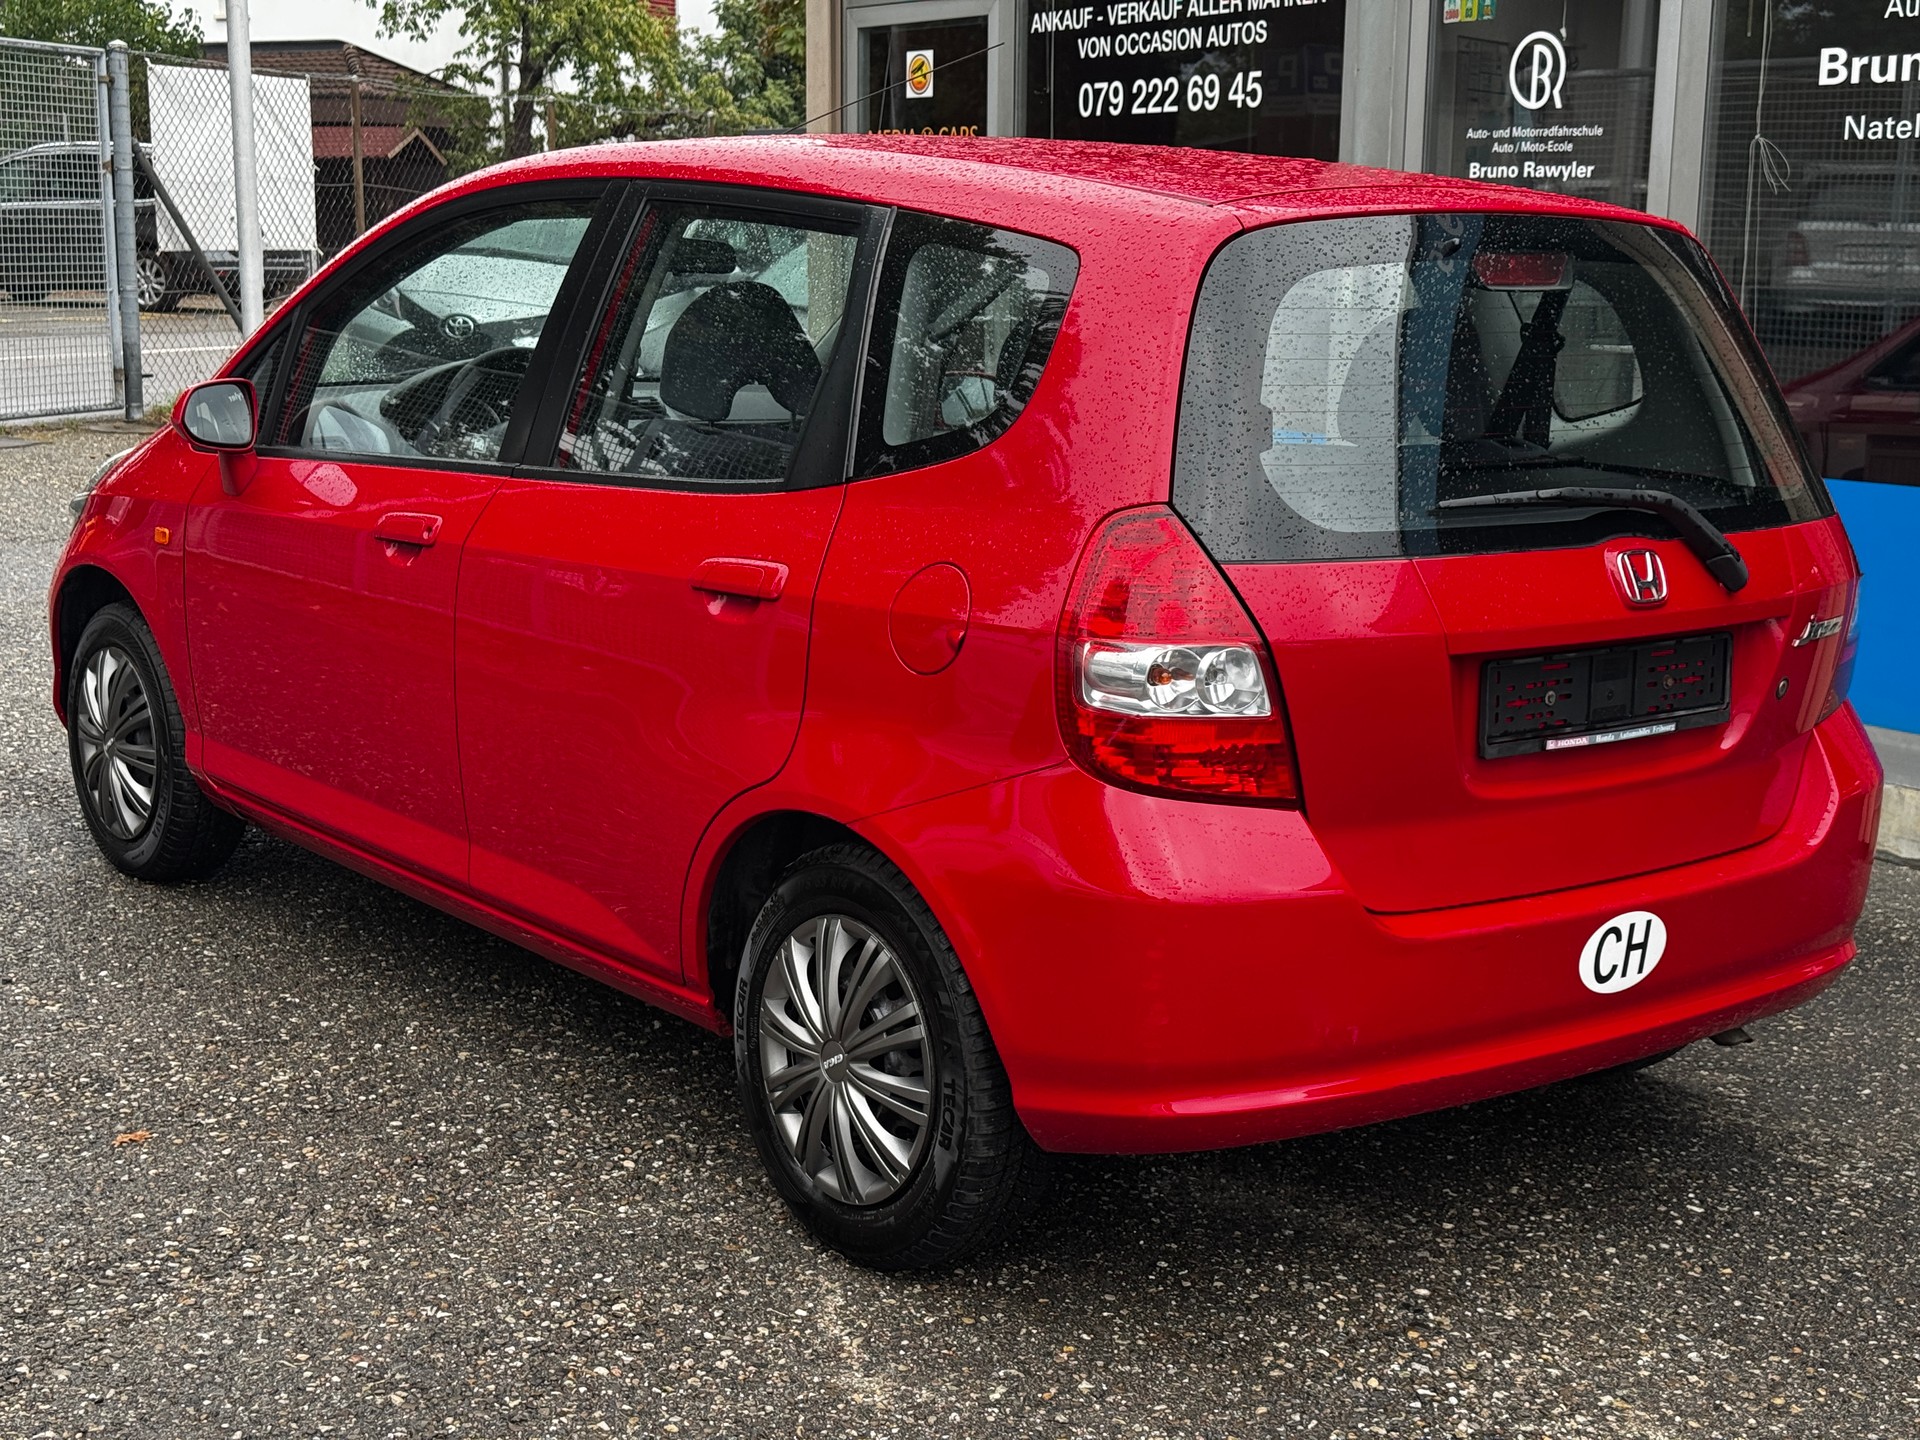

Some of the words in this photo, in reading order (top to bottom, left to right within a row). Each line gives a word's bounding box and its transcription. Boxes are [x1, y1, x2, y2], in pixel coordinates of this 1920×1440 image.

[1030, 6, 1094, 34] ANKAUF
[1107, 0, 1183, 26] VERKAUF
[1186, 0, 1242, 18] ALLER
[1077, 35, 1111, 59] VON
[1114, 26, 1202, 57] OCCASION
[1206, 19, 1268, 48] AUTOS
[1078, 80, 1124, 118] 079
[1131, 76, 1179, 115] 222
[1187, 73, 1221, 112] 69
[1227, 70, 1263, 109] 45
[1466, 127, 1491, 139] Auto-
[1492, 126, 1510, 138] und
[1511, 124, 1604, 138] Motorradfahrschule
[1491, 142, 1514, 153] Auto
[1520, 140, 1574, 153] Moto-Ecole
[1468, 162, 1519, 179] Bruno
[1523, 160, 1595, 182] Rawyler
[1557, 736, 1589, 748] HONDA
[1594, 919, 1652, 984] CH
